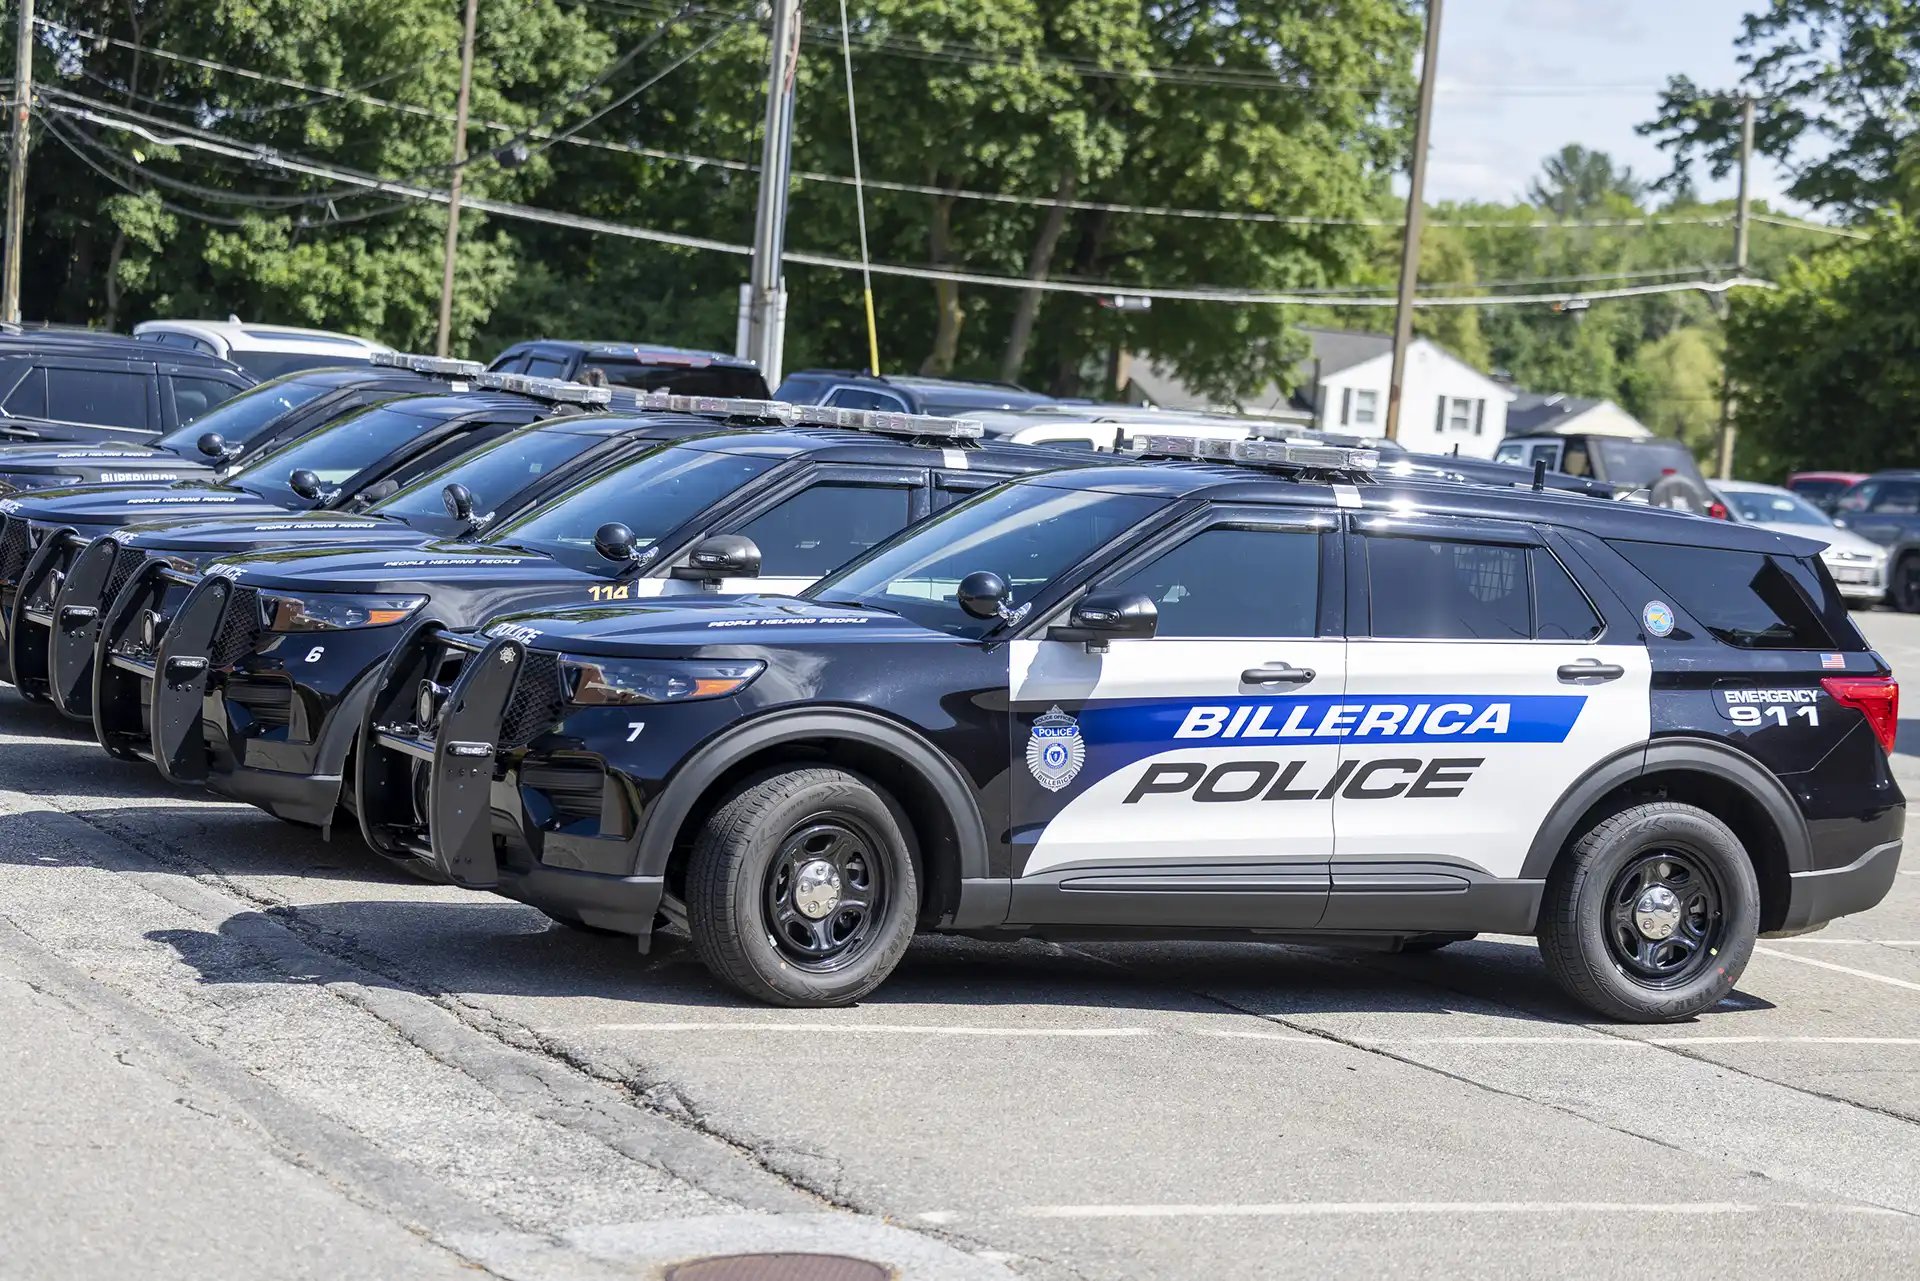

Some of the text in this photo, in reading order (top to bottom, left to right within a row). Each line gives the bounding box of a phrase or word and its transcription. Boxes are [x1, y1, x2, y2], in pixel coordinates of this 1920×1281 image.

[588, 585, 629, 601] 114
[708, 619, 758, 628] PEOPLE
[486, 622, 544, 645] POLICE
[304, 646, 325, 663] 6
[1723, 689, 1818, 703] EMERGENCY
[1173, 703, 1511, 739] BILLERICA
[1728, 705, 1819, 727] 911
[626, 722, 645, 742] 7
[1038, 728, 1073, 737] POLICE
[1037, 774, 1074, 786] BILLERICA
[1122, 757, 1486, 804] POLICE
